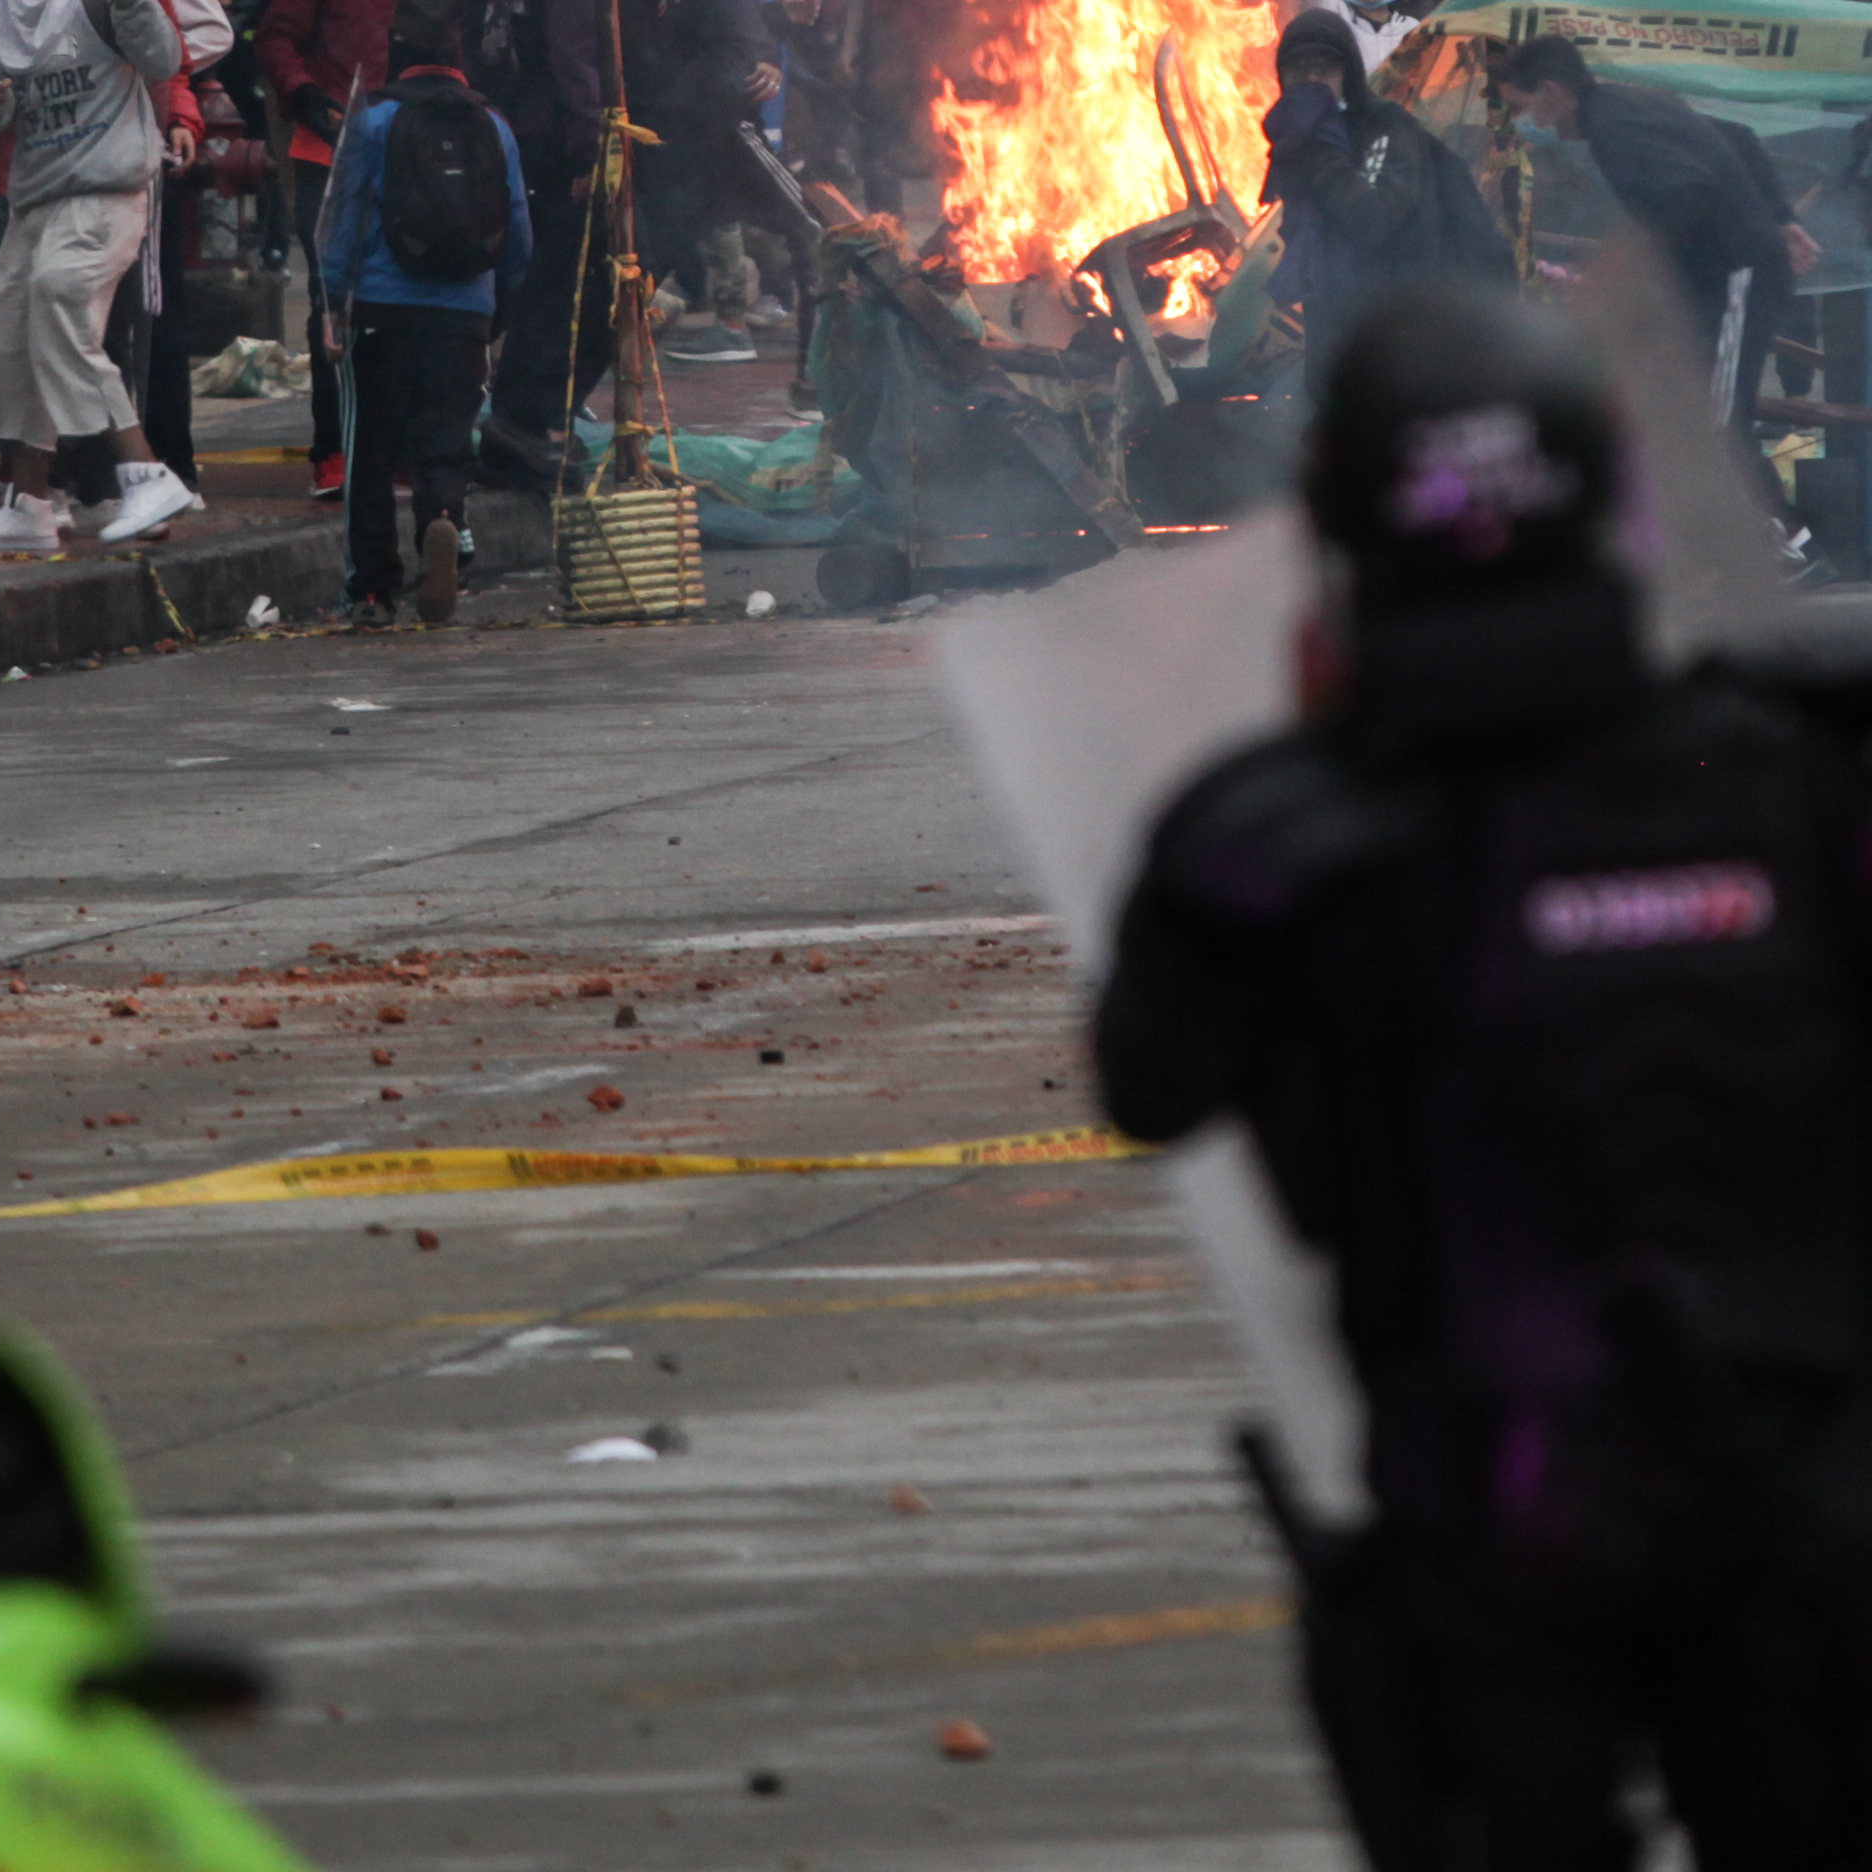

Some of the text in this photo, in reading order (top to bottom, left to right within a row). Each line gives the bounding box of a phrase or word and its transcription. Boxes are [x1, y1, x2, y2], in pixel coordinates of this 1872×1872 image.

[1546, 17, 1761, 48] PELIGRO NO PASE
[34, 64, 96, 101] YORK
